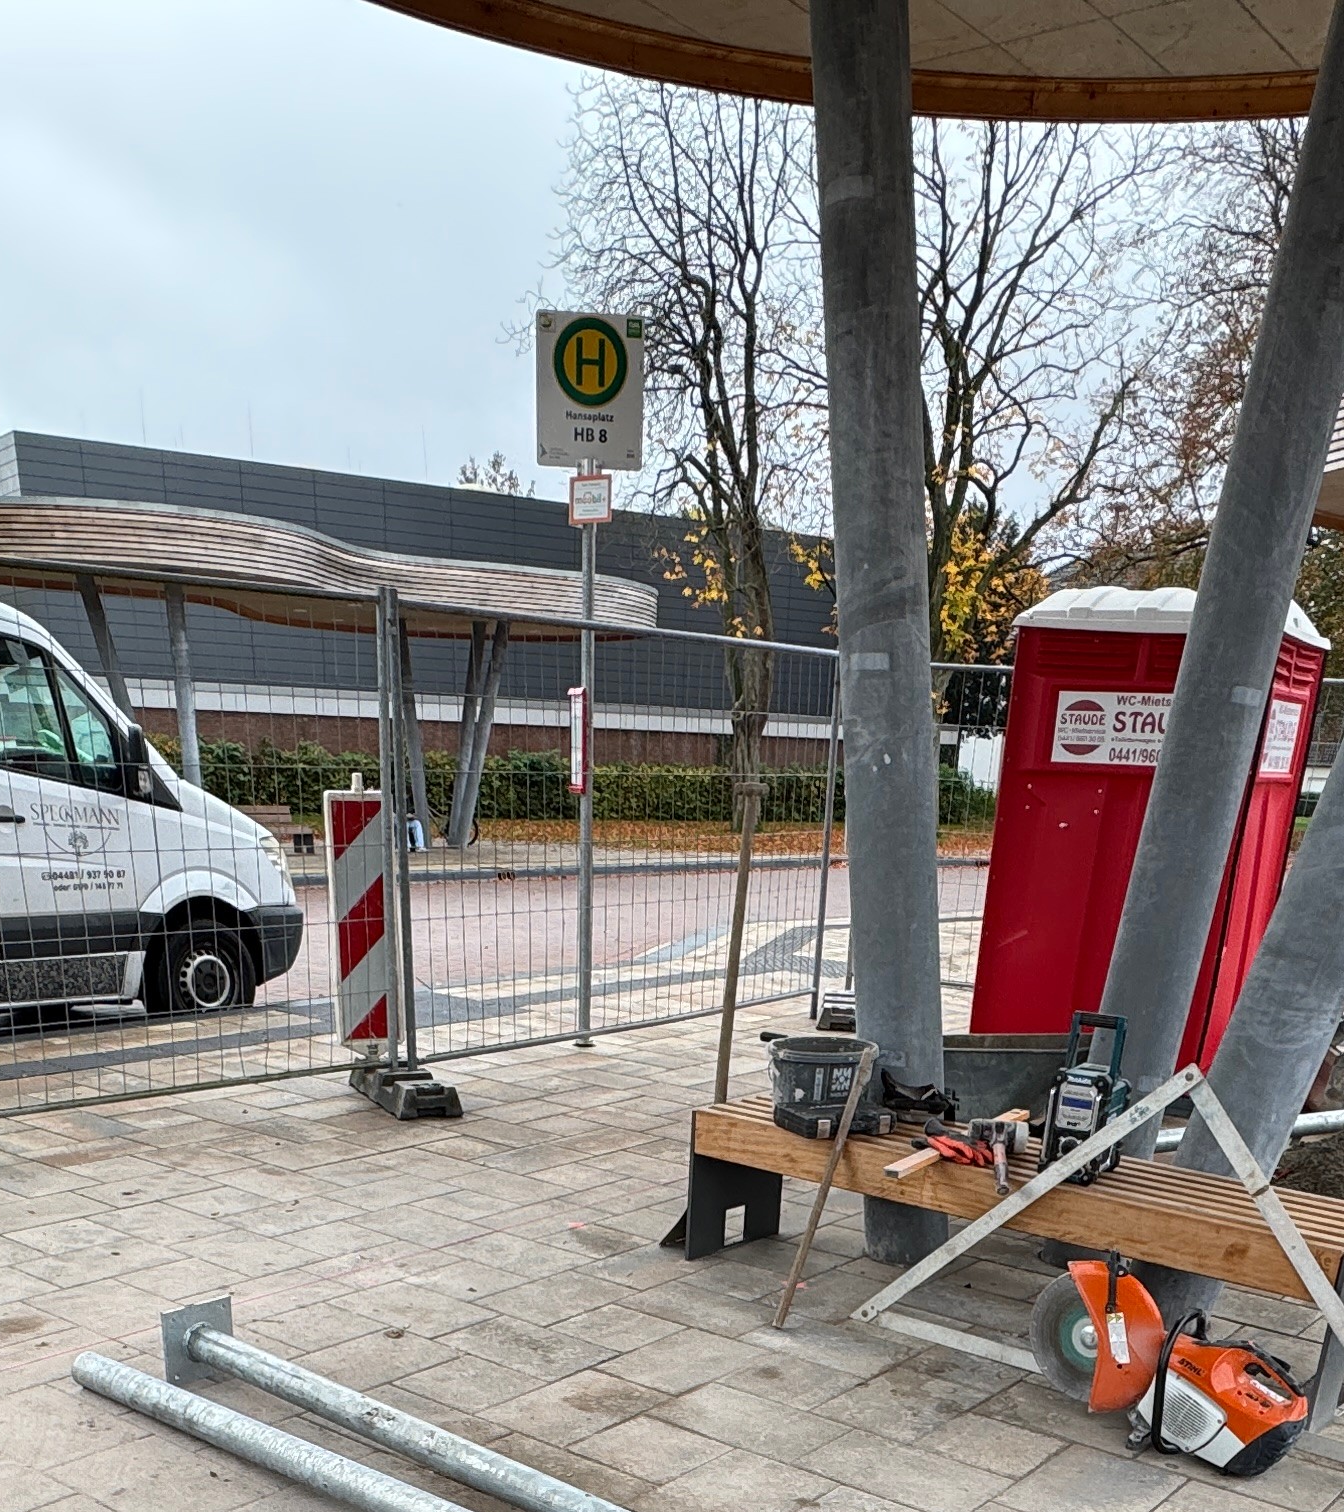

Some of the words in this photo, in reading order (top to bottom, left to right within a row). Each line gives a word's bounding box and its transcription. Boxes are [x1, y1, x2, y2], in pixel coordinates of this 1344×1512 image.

[576, 337, 605, 387] H
[565, 410, 614, 423] Hansaplatz
[574, 427, 595, 442] HB
[599, 428, 608, 443] 8
[1117, 695, 1171, 707] WC-Miets
[1060, 713, 1106, 726] STAUDE
[1112, 711, 1165, 734] STAU
[1109, 748, 1161, 763] 0441/96
[30, 803, 120, 826] SPECKMANN
[86, 870, 101, 879] 937
[1178, 1358, 1202, 1377] STIHL
